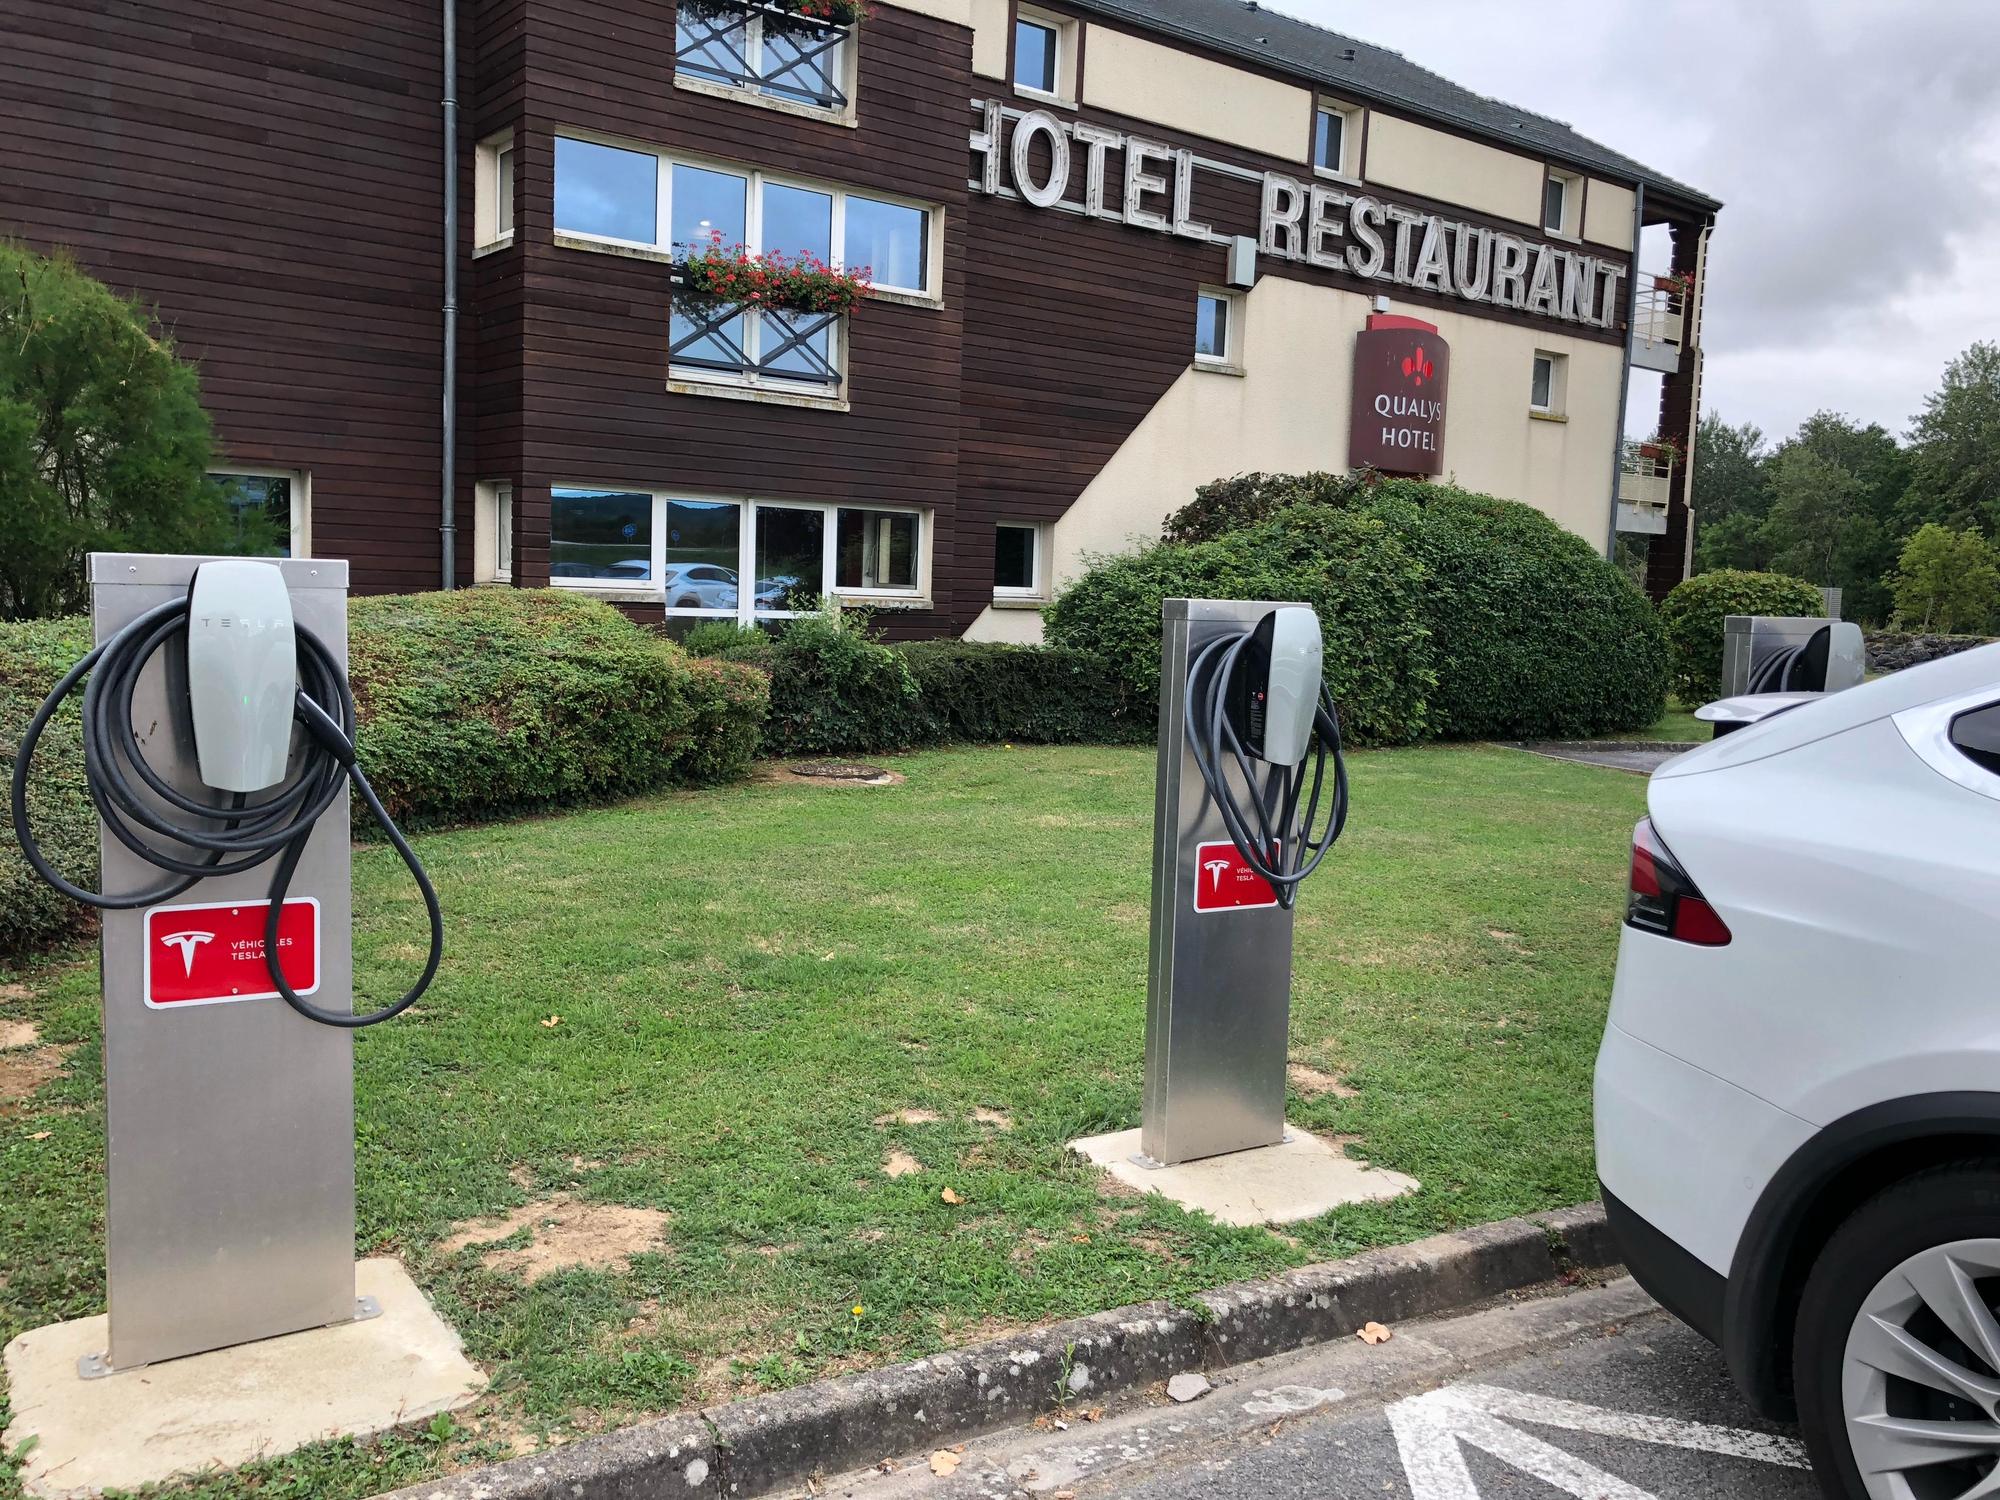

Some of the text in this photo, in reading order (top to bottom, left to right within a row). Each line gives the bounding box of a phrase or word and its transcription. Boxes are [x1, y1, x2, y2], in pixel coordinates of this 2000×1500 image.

[969, 98, 1627, 329] HOTEL RESTAURANT
[1382, 427, 1436, 451] HOTEL
[231, 938, 293, 949] VÉHICES
[231, 951, 266, 960] TESLA
